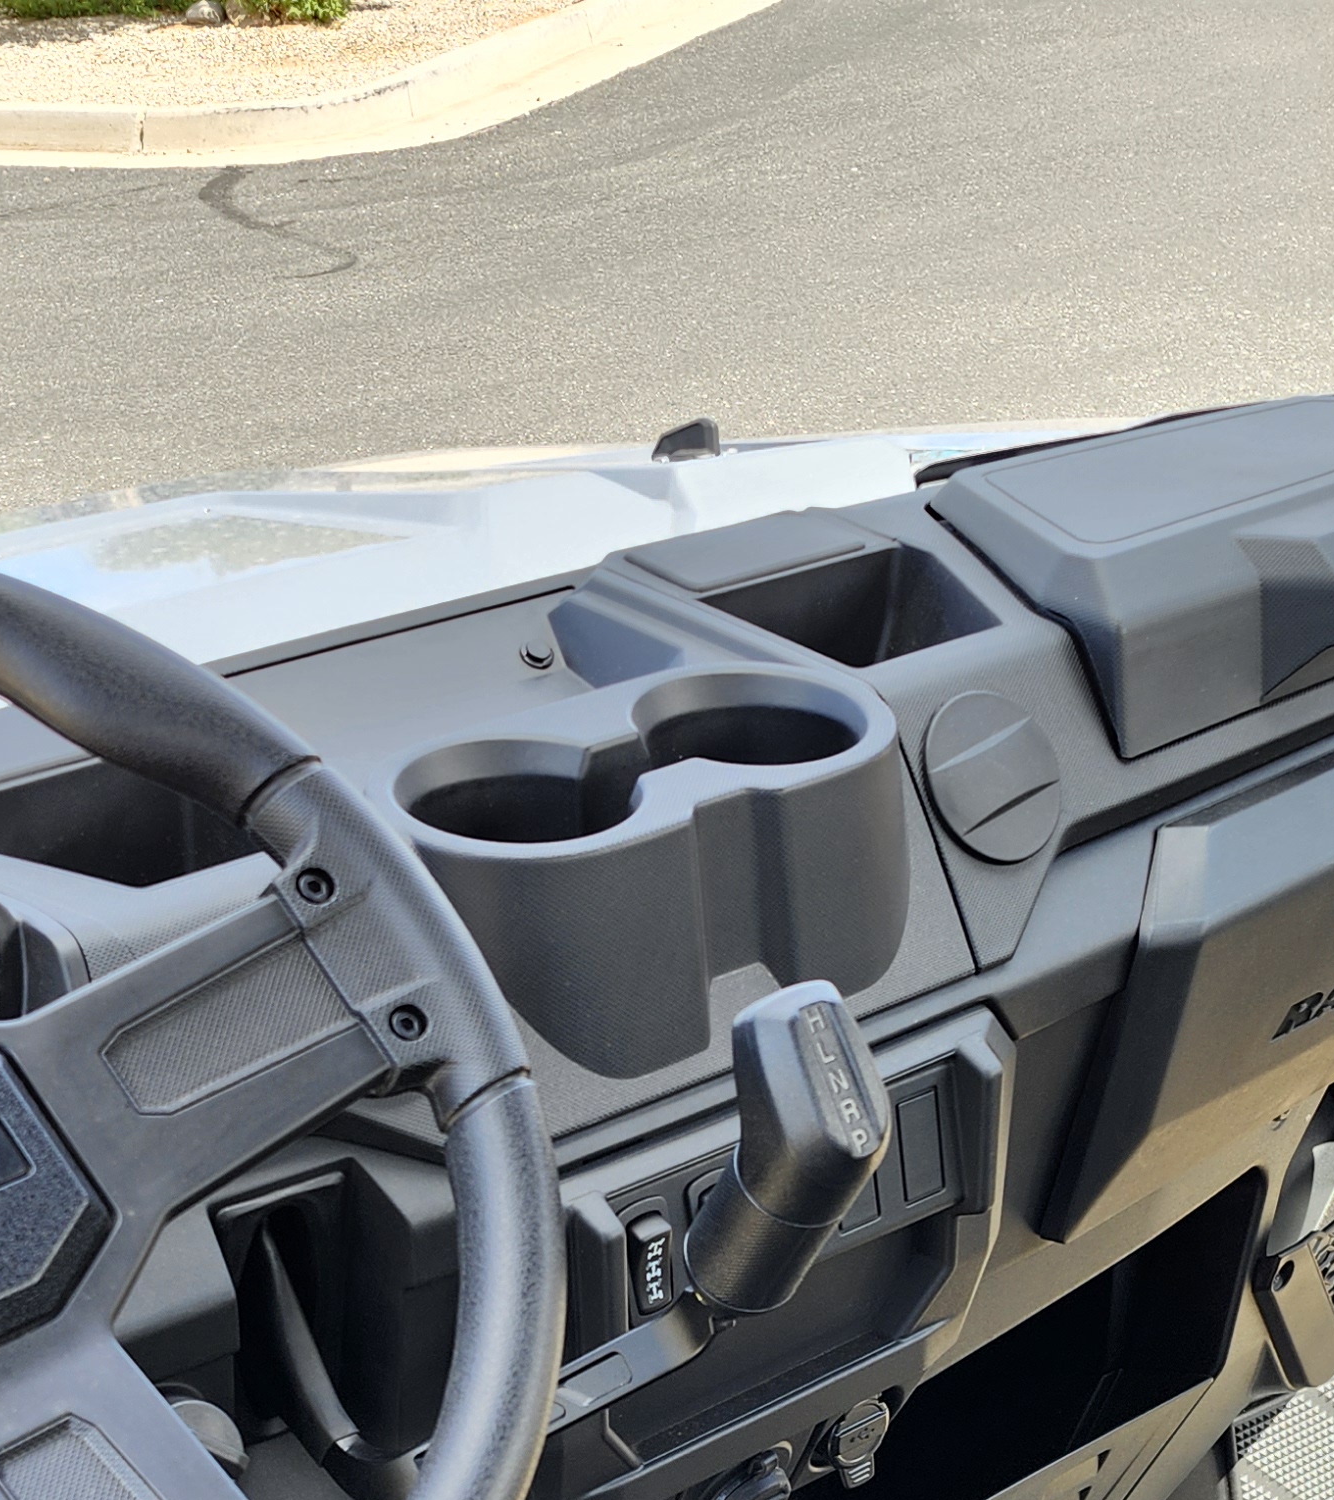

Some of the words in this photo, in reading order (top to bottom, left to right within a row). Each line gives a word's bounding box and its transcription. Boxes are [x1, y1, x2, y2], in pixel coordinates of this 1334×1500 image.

[805, 1006, 825, 1034] H
[817, 1042, 835, 1064] L
[828, 1068, 849, 1094] N
[840, 1098, 861, 1124] R
[851, 1128, 867, 1154] P
